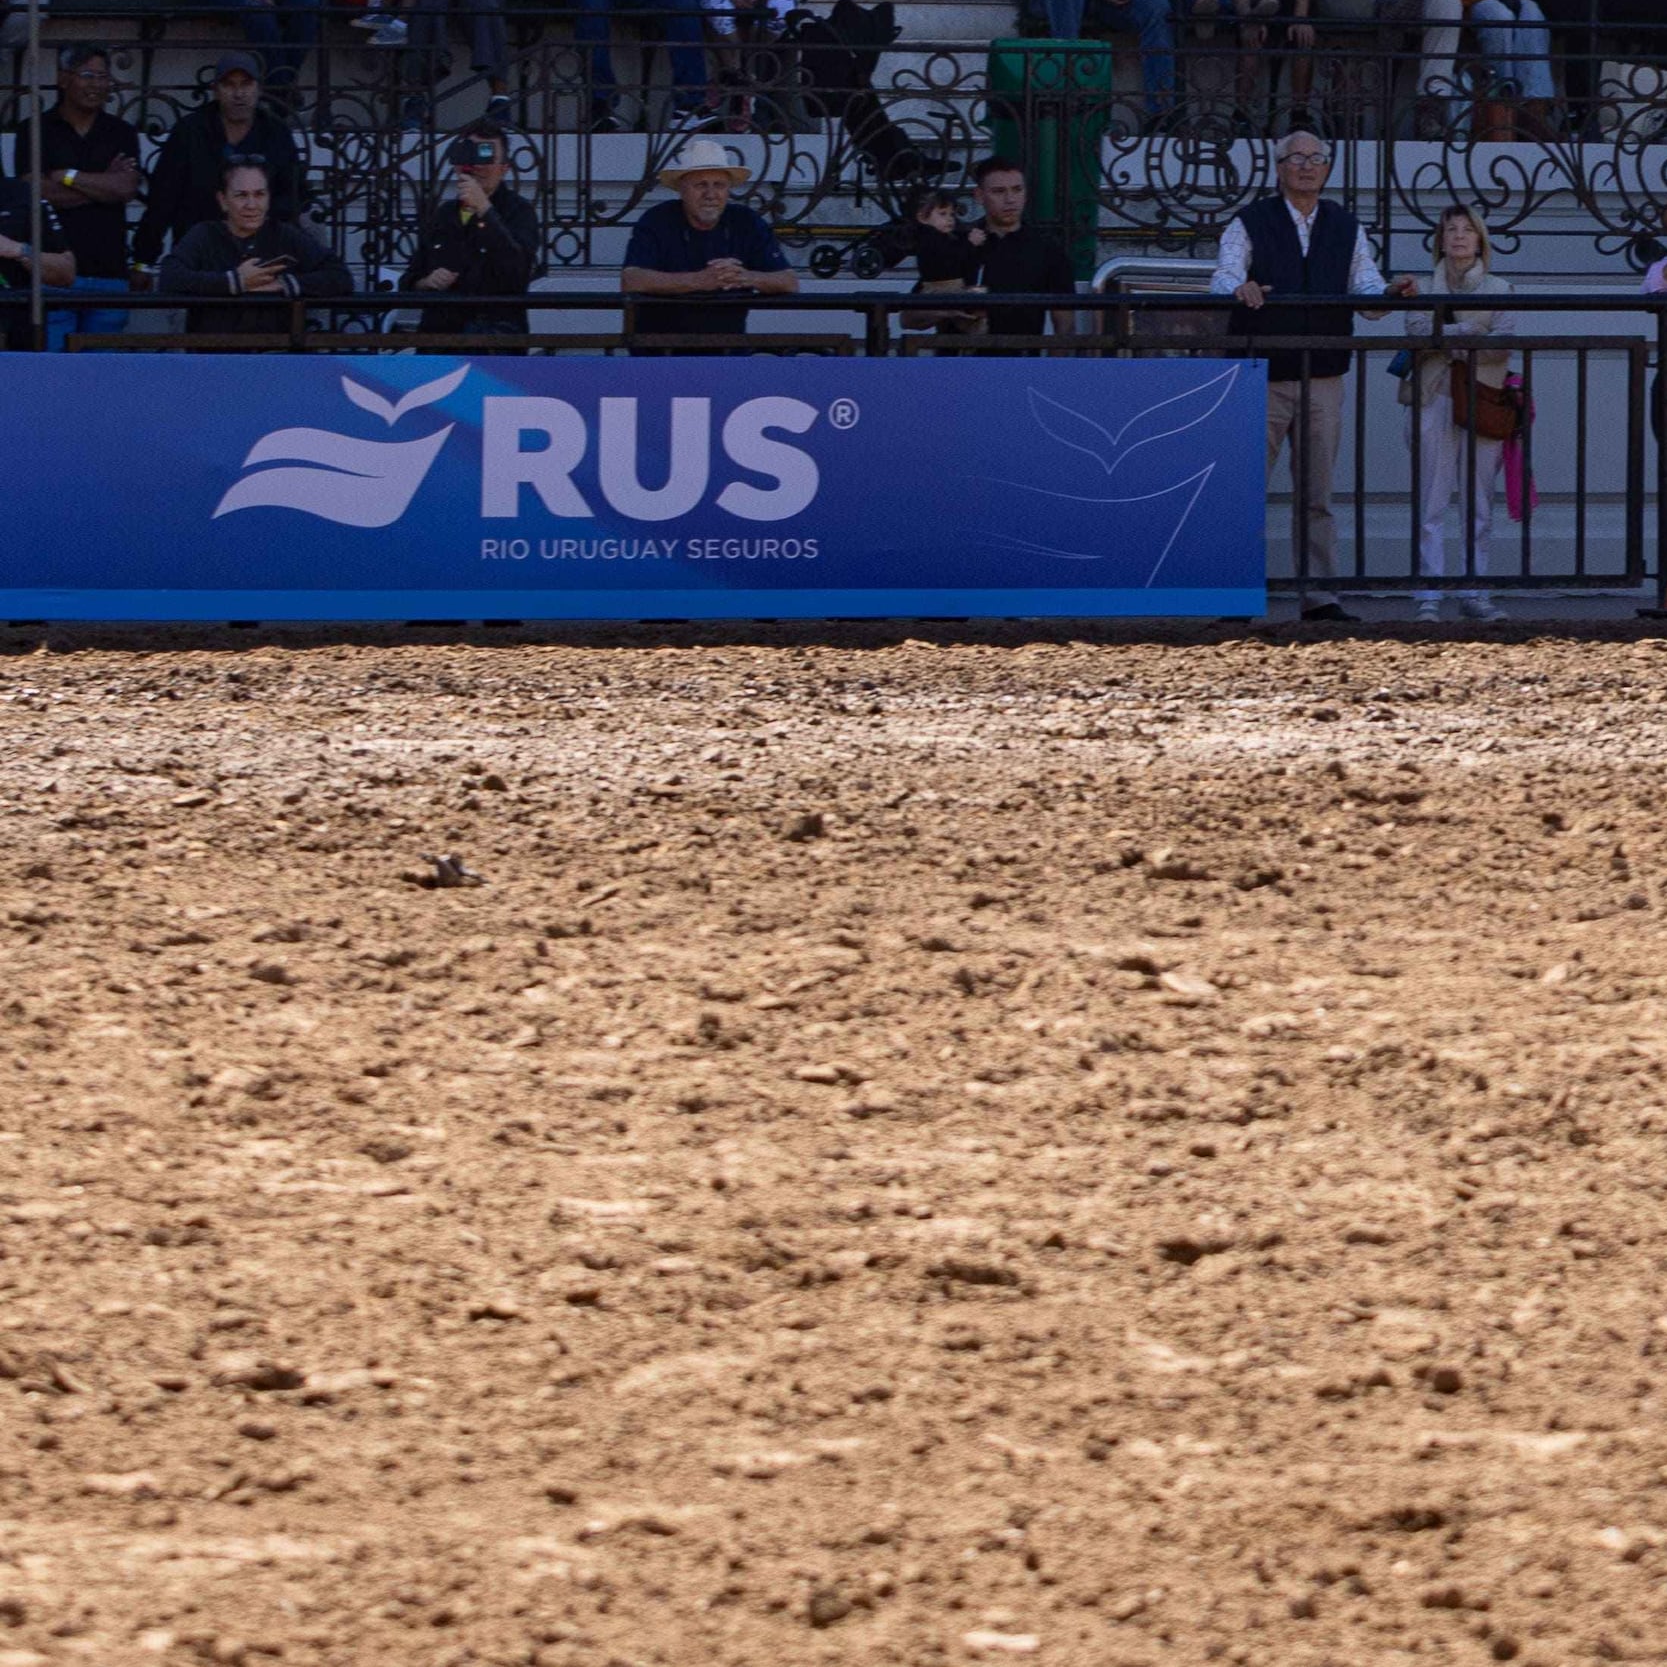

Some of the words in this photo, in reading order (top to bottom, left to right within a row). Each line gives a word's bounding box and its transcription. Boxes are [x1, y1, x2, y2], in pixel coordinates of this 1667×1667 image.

[480, 538, 530, 560] RIO
[540, 538, 679, 560] URUGUAY
[686, 538, 819, 560] SEGUROS
